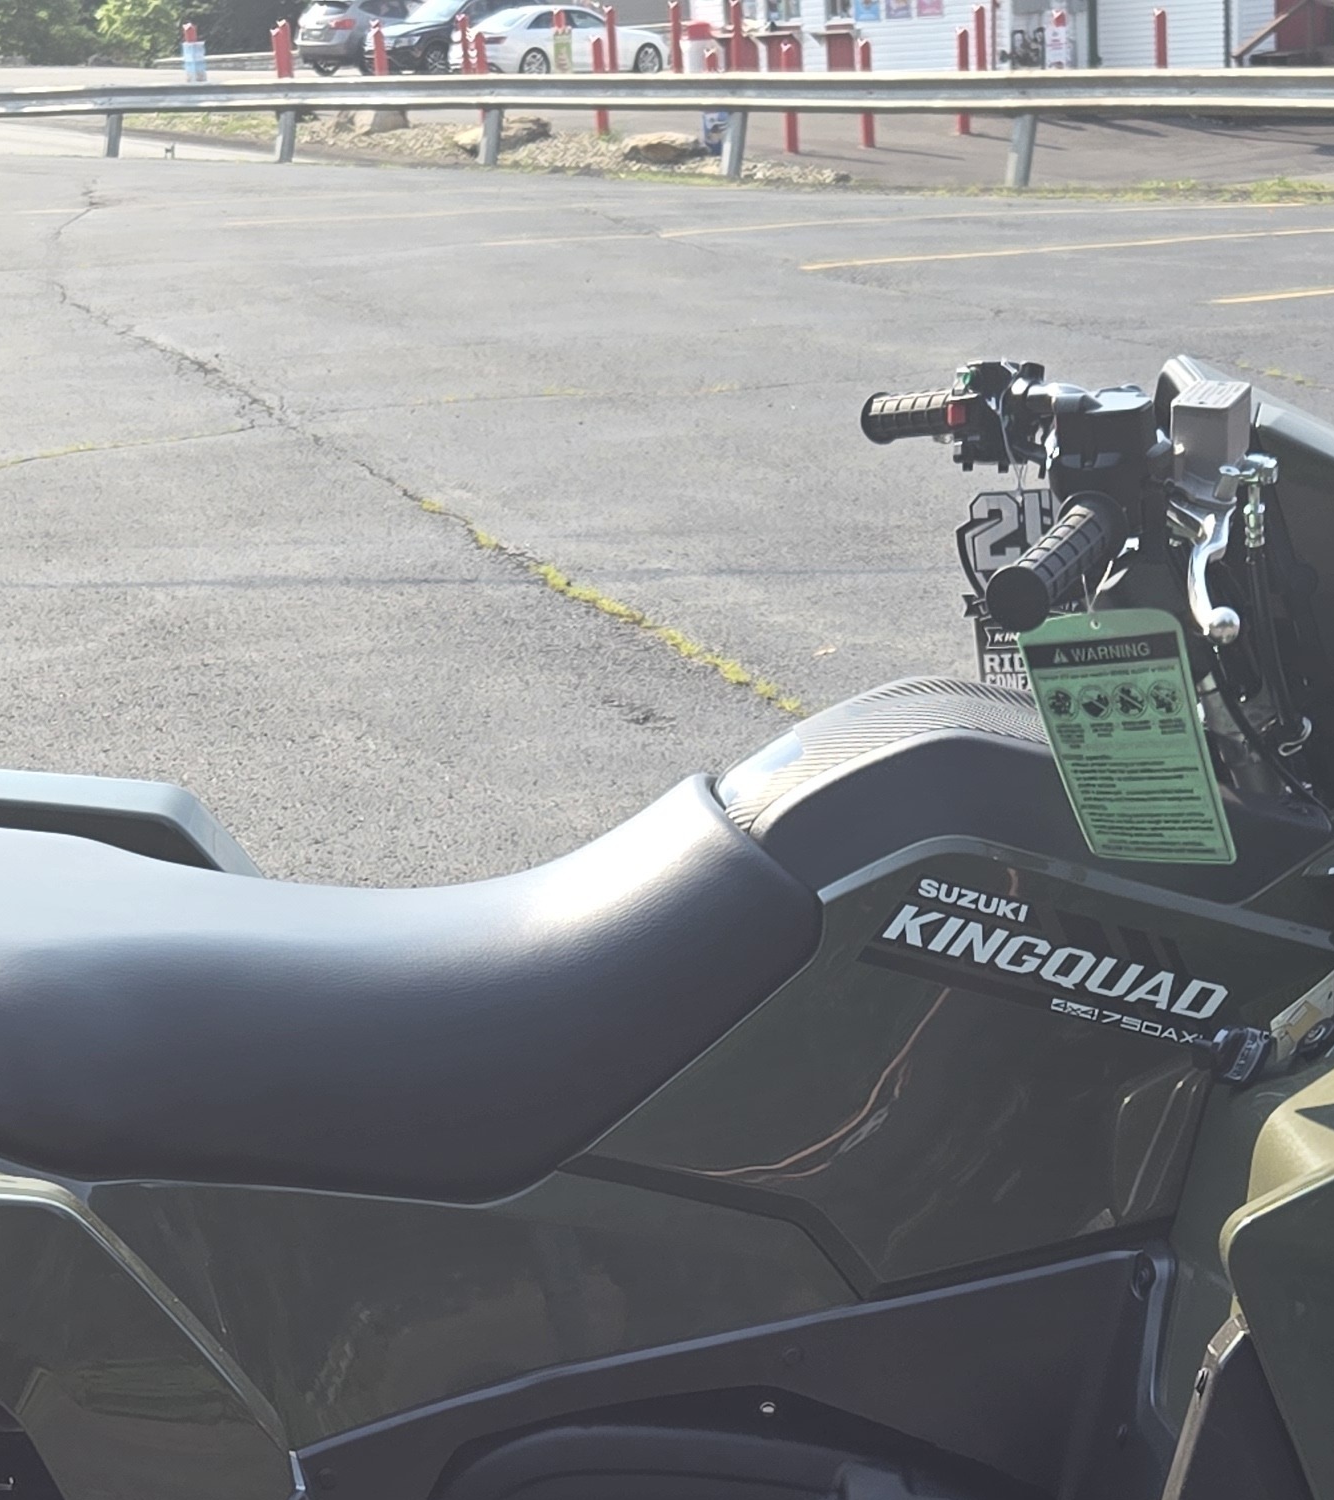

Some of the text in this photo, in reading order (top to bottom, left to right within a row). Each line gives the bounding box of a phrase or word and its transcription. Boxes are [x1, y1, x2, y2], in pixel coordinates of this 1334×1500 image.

[993, 632, 1020, 642] KIN
[1071, 642, 1151, 662] WARNING
[983, 653, 1026, 673] RID
[986, 673, 1030, 690] CONF
[918, 878, 1029, 922] SUZUKI
[881, 904, 1229, 1020] KINGQUAD
[1101, 1010, 1204, 1043] 750AX
